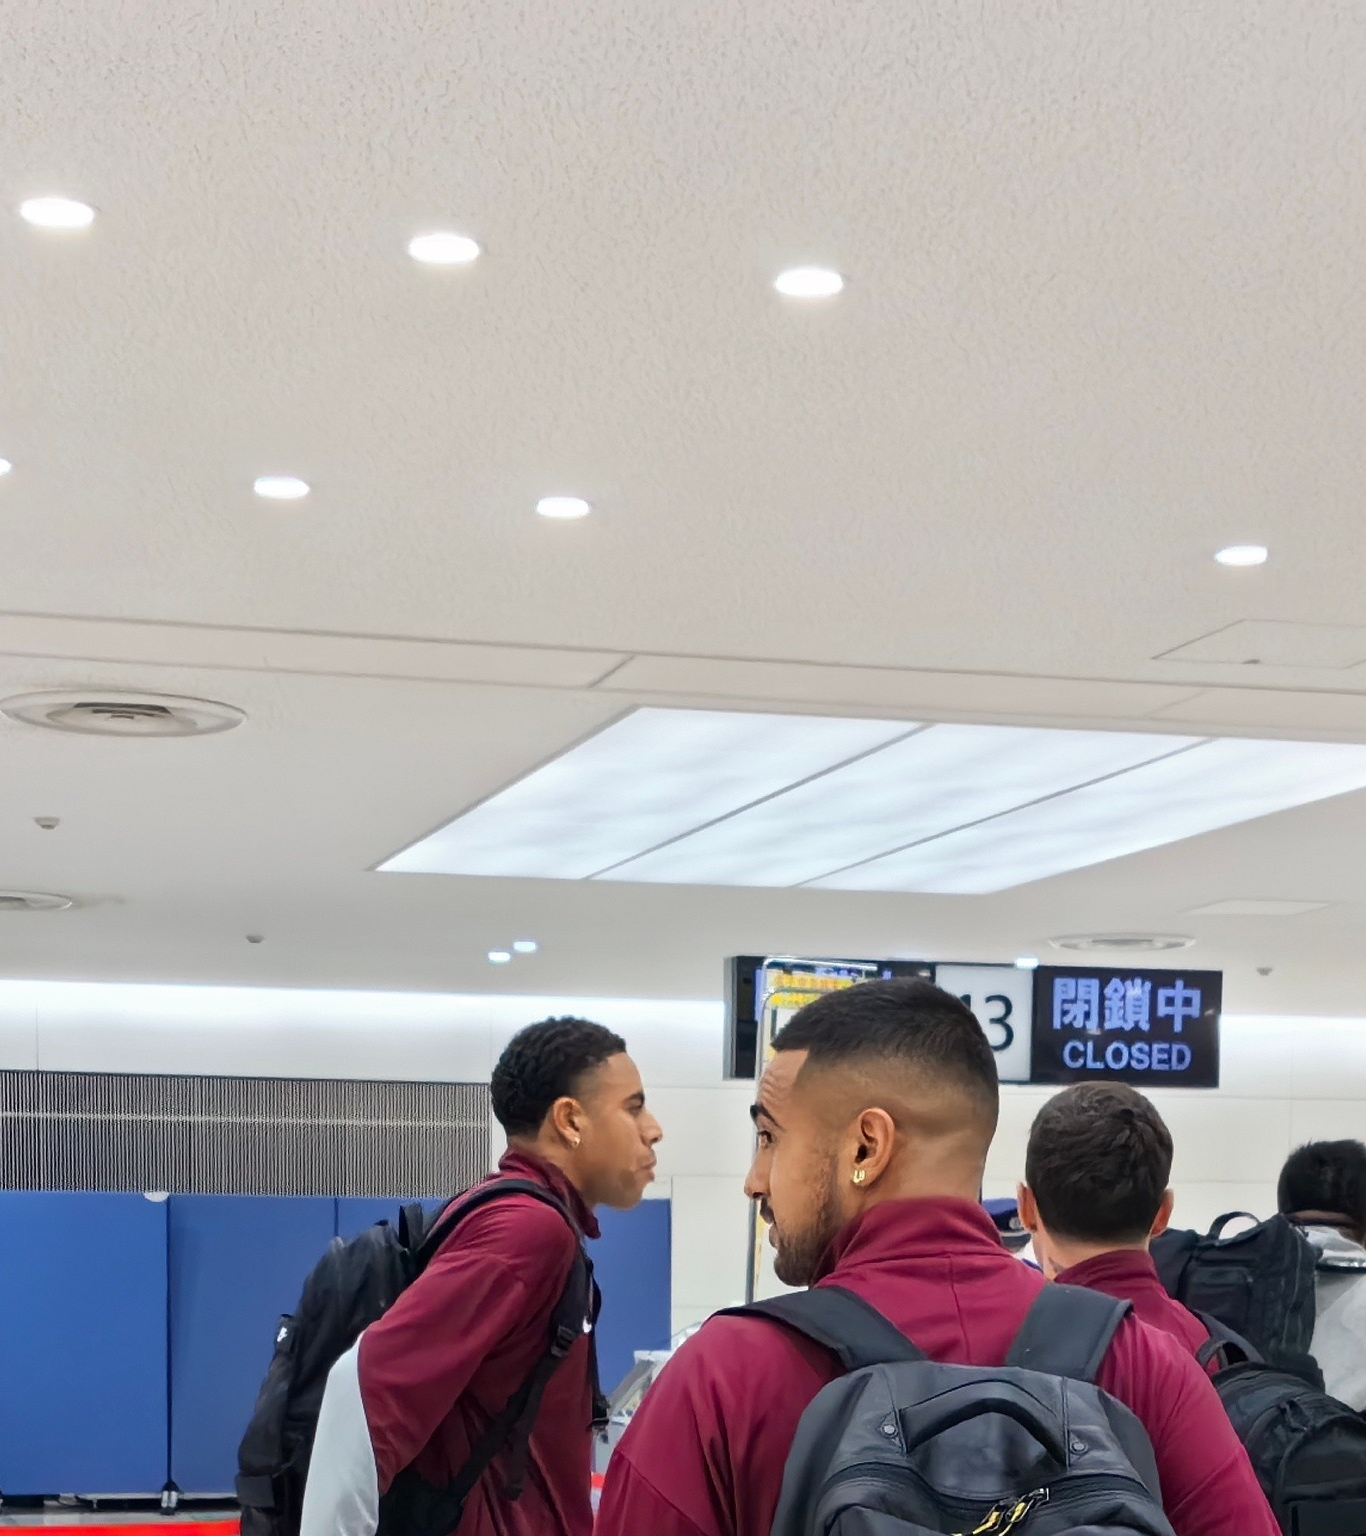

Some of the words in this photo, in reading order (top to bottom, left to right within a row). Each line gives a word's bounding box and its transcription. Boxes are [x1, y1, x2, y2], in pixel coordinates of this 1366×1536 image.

[960, 994, 1014, 1052] 3
[1052, 977, 1202, 1033] 閉鎖中
[1062, 1039, 1192, 1072] CLOSED
